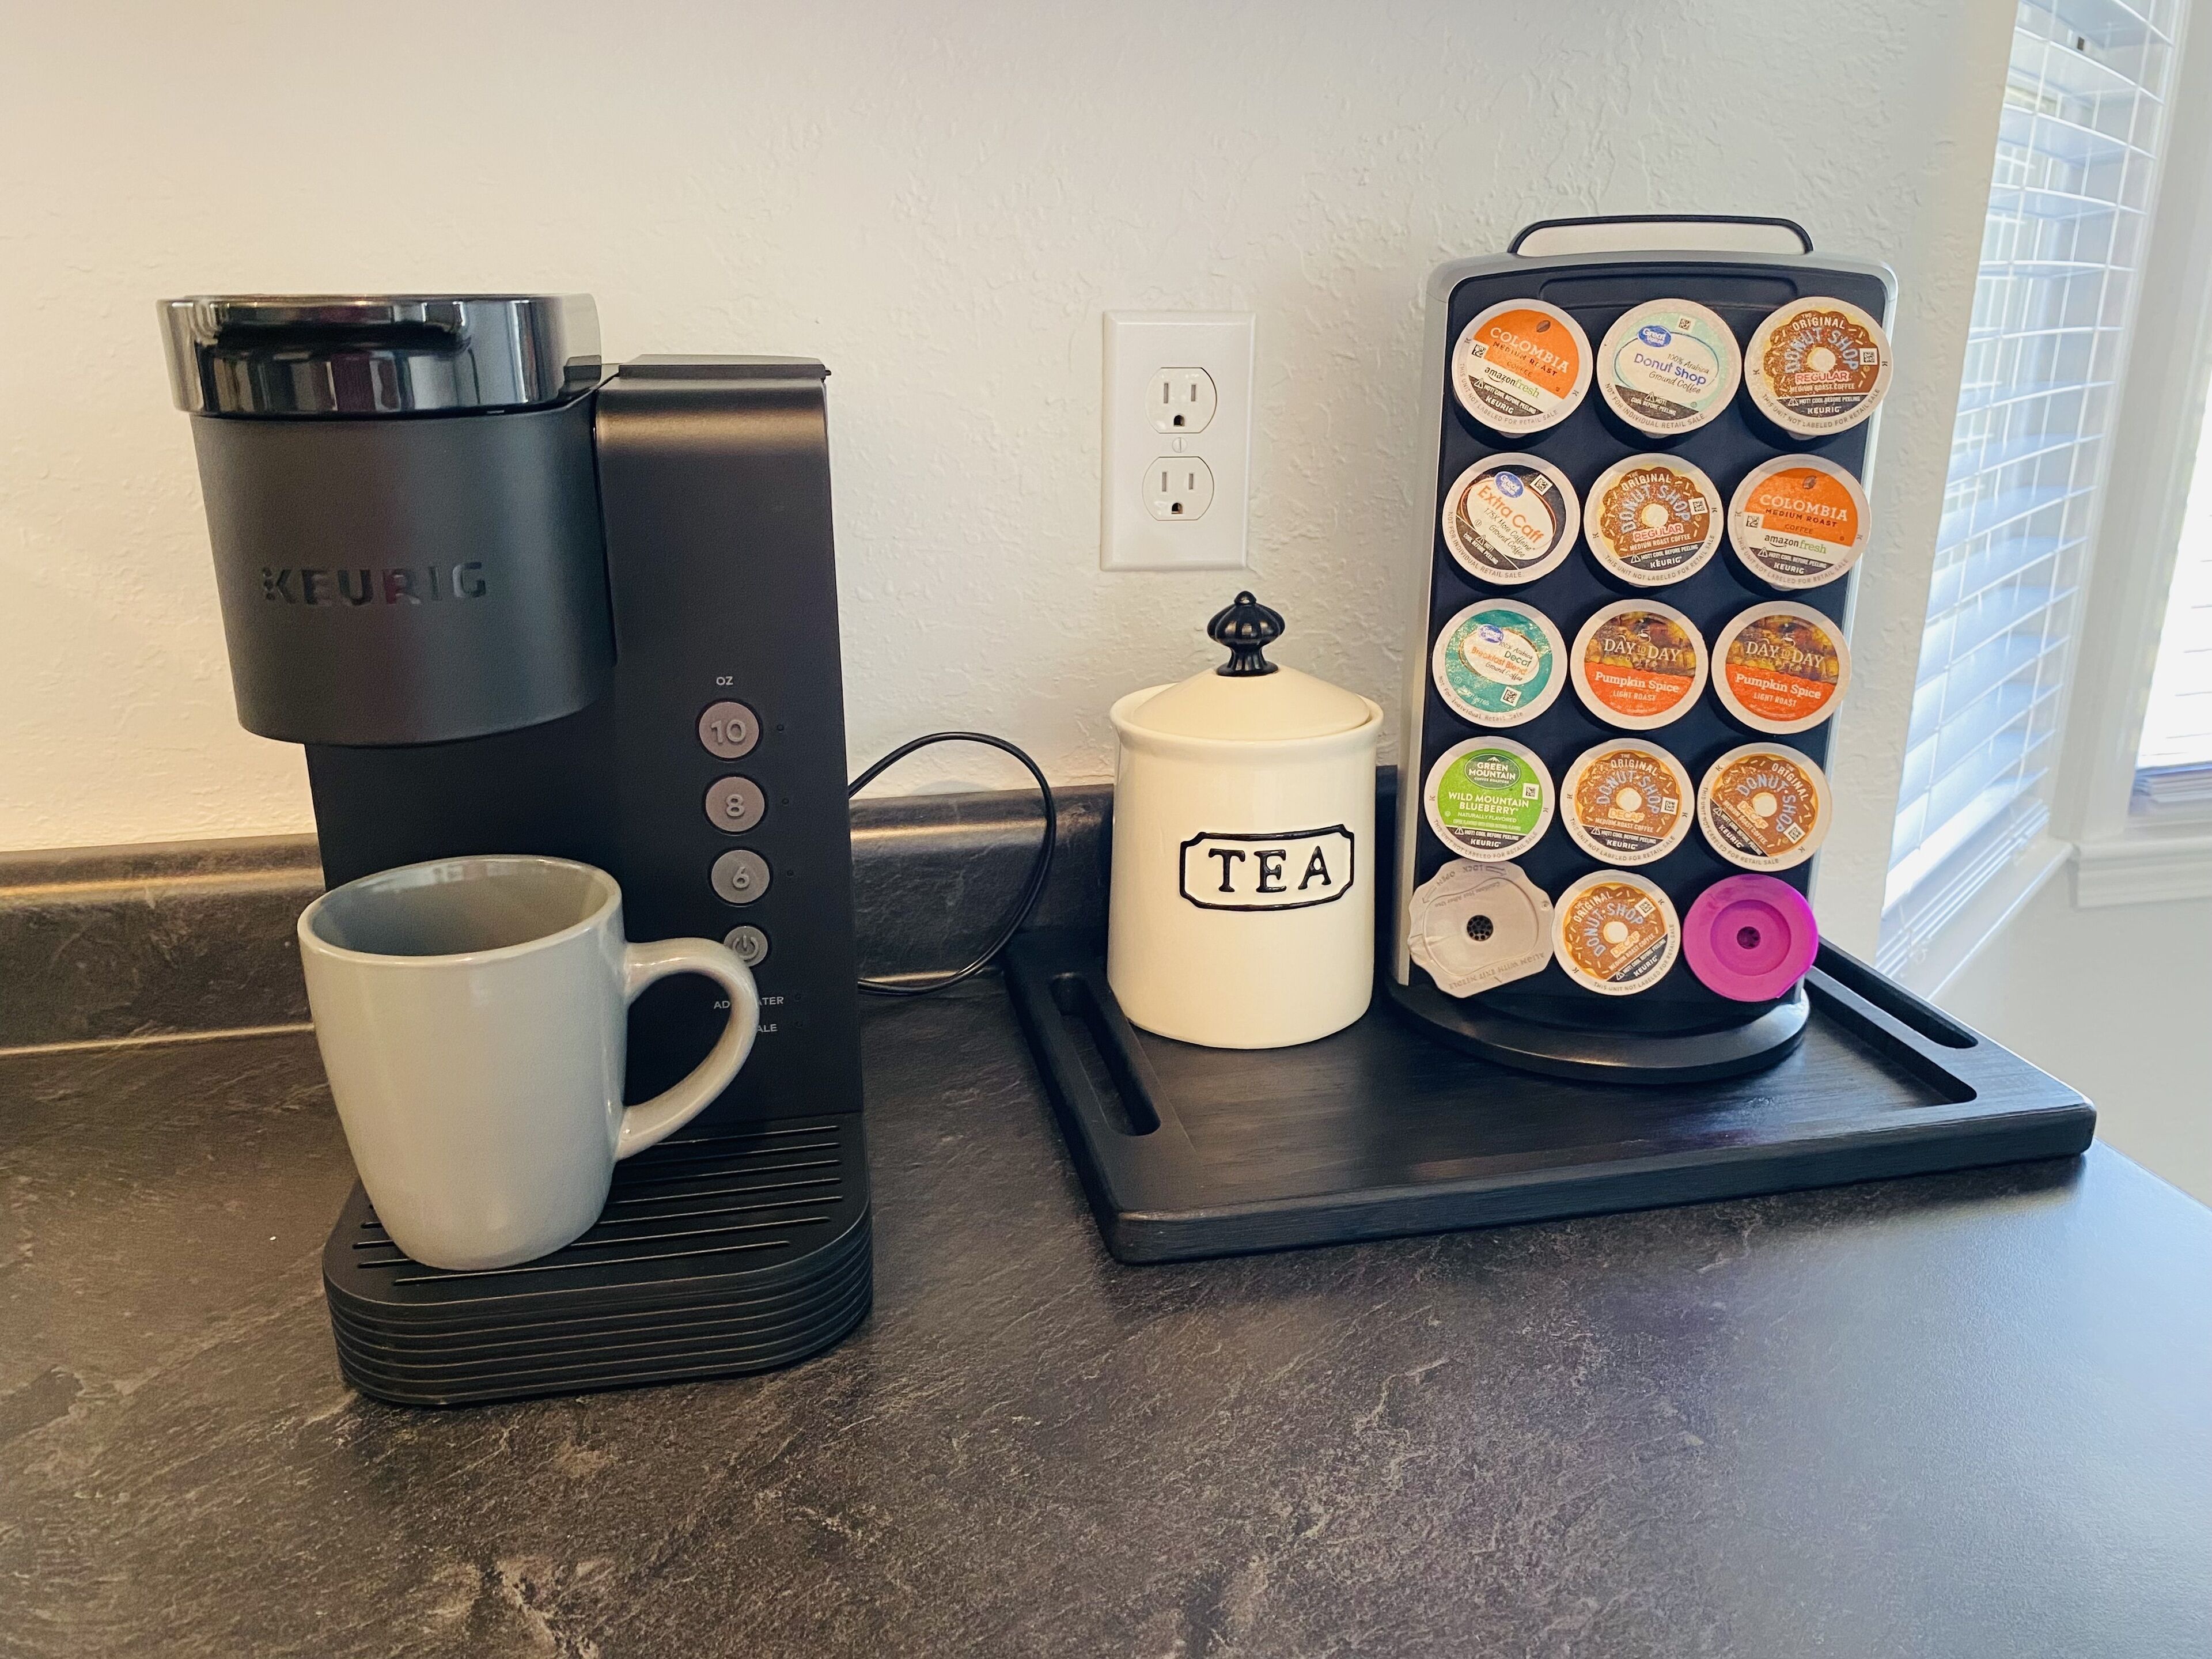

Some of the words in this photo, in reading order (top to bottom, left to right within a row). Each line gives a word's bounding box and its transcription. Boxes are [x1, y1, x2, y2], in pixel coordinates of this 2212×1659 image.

[1792, 317, 1844, 331] ORIGINAL
[1490, 327, 1569, 373] COLOMBIA
[1493, 341, 1527, 361] MEDIUM
[1529, 358, 1557, 376] ROAST
[1827, 329, 1859, 370] SHOP
[1507, 361, 1532, 377] COFFEE
[1634, 353, 1673, 372] Donut
[1649, 371, 1676, 385] Ground
[1677, 380, 1700, 394] Coffee
[1795, 370, 1849, 384] REGULAR
[1486, 396, 1514, 414] KEURIG
[1605, 382, 1614, 395] NOT
[1613, 396, 1622, 410] FOR
[1623, 407, 1658, 427] INDIVIDUAL
[1688, 414, 1705, 425] SALE
[1763, 394, 1774, 408] THIS
[1772, 408, 1786, 419] UNIT
[1787, 416, 1801, 426] NOT
[1834, 416, 1848, 426] FOR
[1850, 404, 1869, 420] RETAIL
[1868, 389, 1880, 404] SALE
[1808, 406, 1841, 414] KEURIG
[1621, 474, 1671, 491] ORIGINAL
[1478, 485, 1513, 518] Extra
[1512, 514, 1544, 544] Caff
[1619, 484, 1650, 534] DONUT
[1658, 484, 1691, 522] SHOP
[1760, 494, 1848, 522] COLOMBIA
[1765, 509, 1802, 521] MEDIUM
[1806, 516, 1838, 527] ROAST
[1489, 524, 1509, 544] Ground
[1506, 540, 1525, 558] Coffee
[1633, 523, 1684, 542] REGULAR
[1785, 524, 1813, 535] COFFEE
[1630, 540, 1652, 551] MEDIUM
[1653, 537, 1671, 546] ROAST
[1671, 534, 1691, 543] COFFEE
[1453, 539, 1478, 569] INDIVIDUAL
[1480, 566, 1502, 578] RETAIL
[1605, 555, 1616, 568] THIS
[1618, 565, 1631, 576] UNIT
[1647, 572, 1676, 581] LABELED
[1677, 566, 1690, 575] FOR
[1691, 550, 1707, 567] RETAIL
[1706, 535, 1715, 550] SALE
[1650, 556, 1682, 568] KEURIG
[1774, 562, 1804, 574] KEURIG
[262, 561, 486, 606] KEURIG
[1472, 646, 1505, 666] Breakfast
[1506, 661, 1527, 675] Blend
[1505, 651, 1532, 667] Decaf
[1604, 638, 1637, 655] DAY
[1647, 645, 1682, 662] DAY
[1746, 641, 1779, 658] DAY
[1791, 649, 1824, 668] DAY
[716, 676, 733, 685] OZ
[1486, 662, 1505, 675] Ground
[1503, 671, 1522, 681] Coffee
[1594, 672, 1646, 688] Pumpkin
[1648, 680, 1680, 693] Spice
[1613, 691, 1633, 699] LIGHT
[1634, 692, 1657, 701] ROAST
[1735, 673, 1787, 692] Pumpkin
[1790, 684, 1821, 699] Spice
[1753, 693, 1772, 702] LIGHT
[1775, 696, 1797, 707] ROAST
[711, 719, 746, 744] 10
[1469, 768, 1516, 781] MOUNTAIN
[1477, 762, 1508, 771] GREEN
[1611, 759, 1658, 777] ORIGINAL
[1596, 770, 1637, 805] DONUT
[1638, 776, 1662, 815] SHOP
[1772, 762, 1809, 801] ORIGINAL
[725, 794, 745, 817] 8
[1449, 792, 1472, 801] WILD
[1475, 795, 1529, 808] MOUNTAIN
[1736, 774, 1788, 797] DONUT
[1776, 794, 1797, 832] SHOP
[1595, 818, 1616, 827] MEDIUM
[1617, 821, 1633, 830] ROAST
[1634, 824, 1653, 833] COFFEE
[1608, 808, 1645, 823] DECAF
[1737, 801, 1768, 829] DECAF
[1471, 839, 1501, 847] KEURIG
[1607, 839, 1638, 850] KEURIG
[1719, 825, 1744, 849] KEURIG
[733, 866, 749, 889] 6
[1208, 845, 1331, 893] TEA
[1574, 891, 1613, 922] ORIGINAL
[1584, 908, 1607, 957] DONUT
[1607, 903, 1644, 925] SHOP
[1611, 931, 1641, 957] DECAF
[1633, 955, 1657, 976] KEURIG
